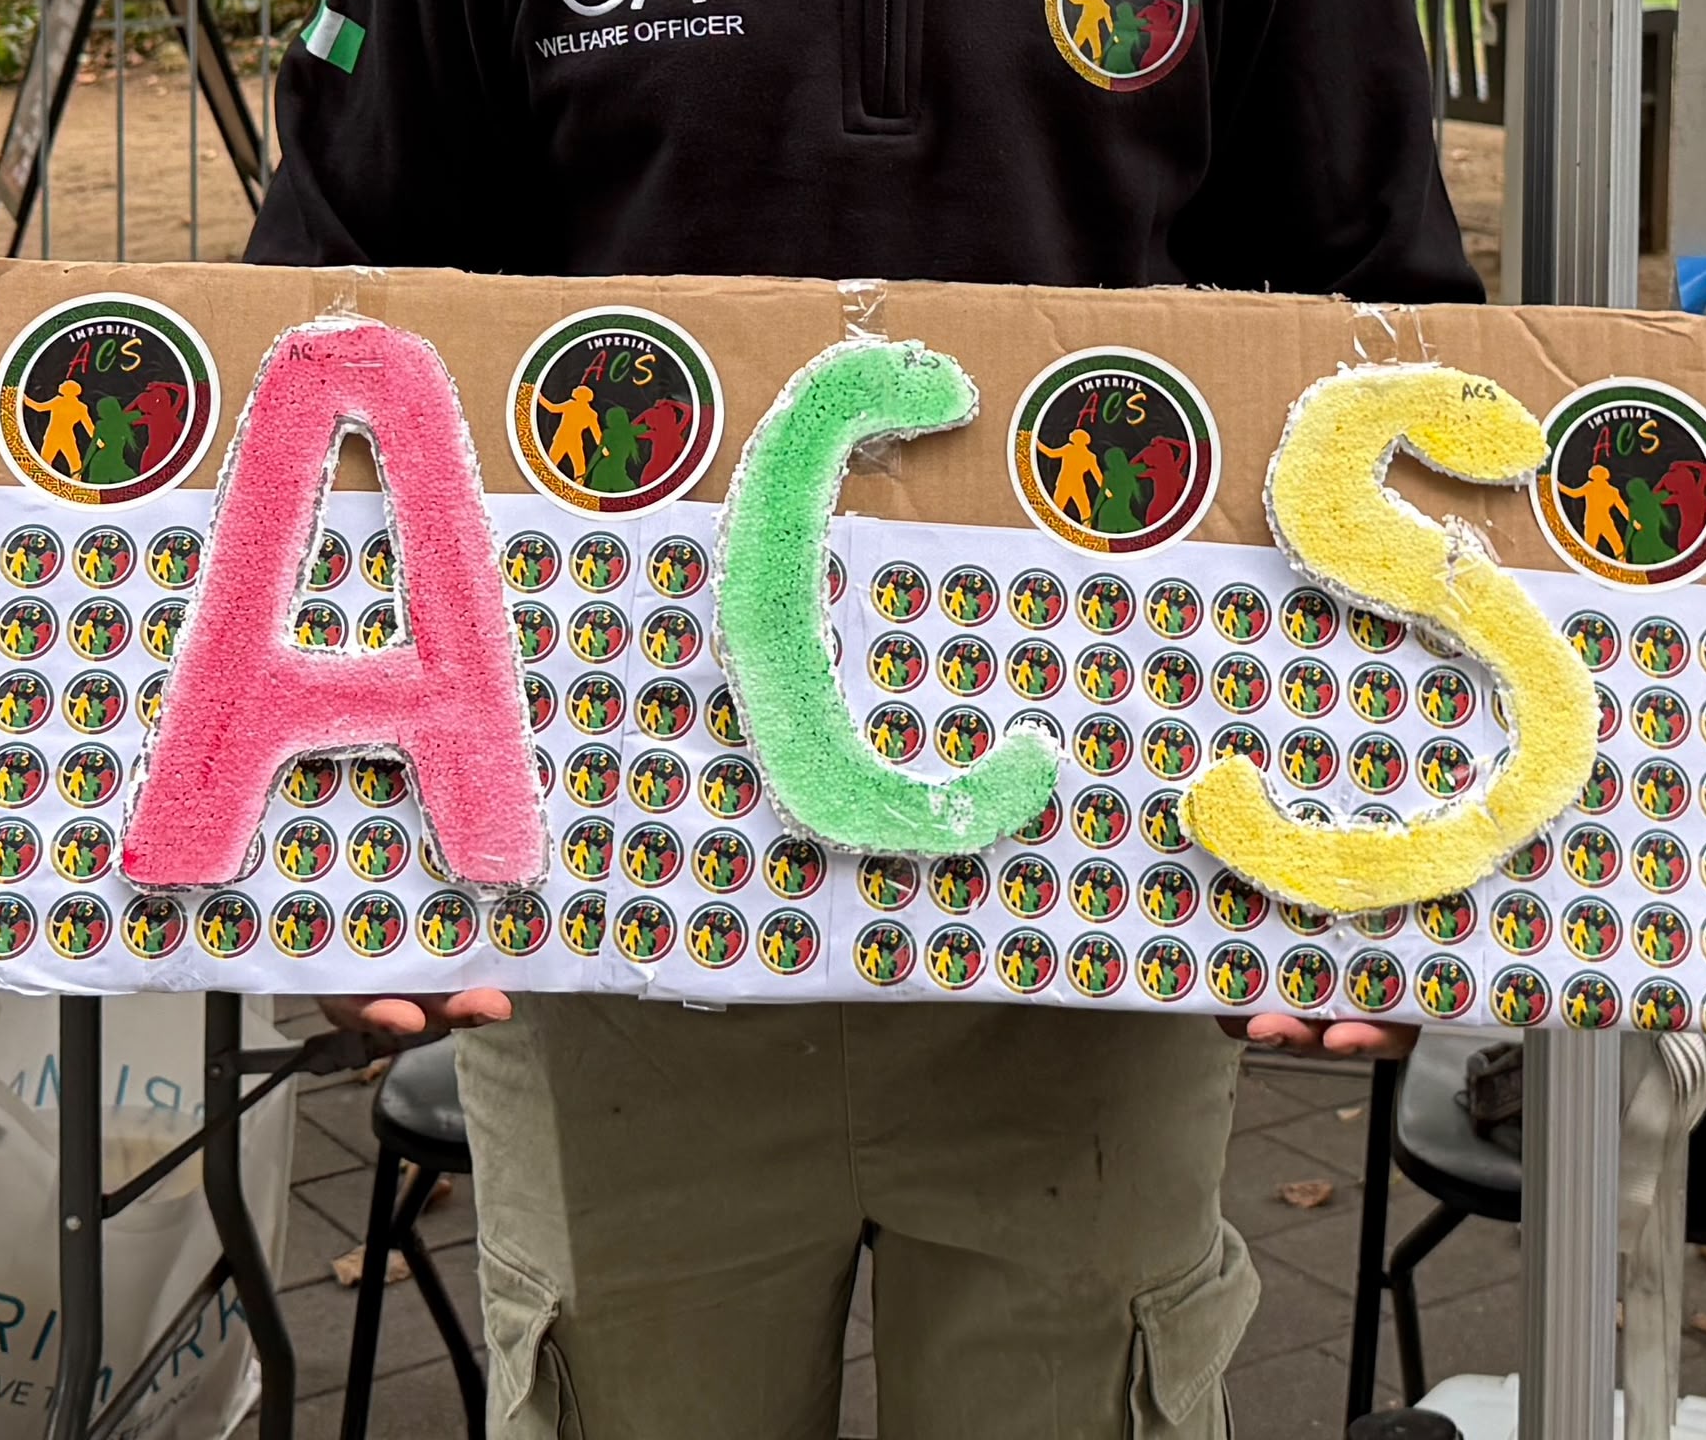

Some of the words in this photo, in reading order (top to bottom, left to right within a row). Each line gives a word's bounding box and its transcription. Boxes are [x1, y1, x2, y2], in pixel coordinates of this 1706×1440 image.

[535, 24, 629, 59] WELFARE
[633, 13, 746, 45] OFFICER
[69, 324, 137, 342] IMPERIAL
[588, 335, 652, 353] IMPERIAL
[66, 337, 142, 380] ACS
[579, 350, 656, 387] ACS
[1079, 378, 1141, 393] IMPERIAL
[1461, 382, 1498, 401] ACS
[1076, 390, 1146, 429] ACS
[1588, 408, 1652, 429] IMPERIAL
[1592, 419, 1660, 465] ACS
